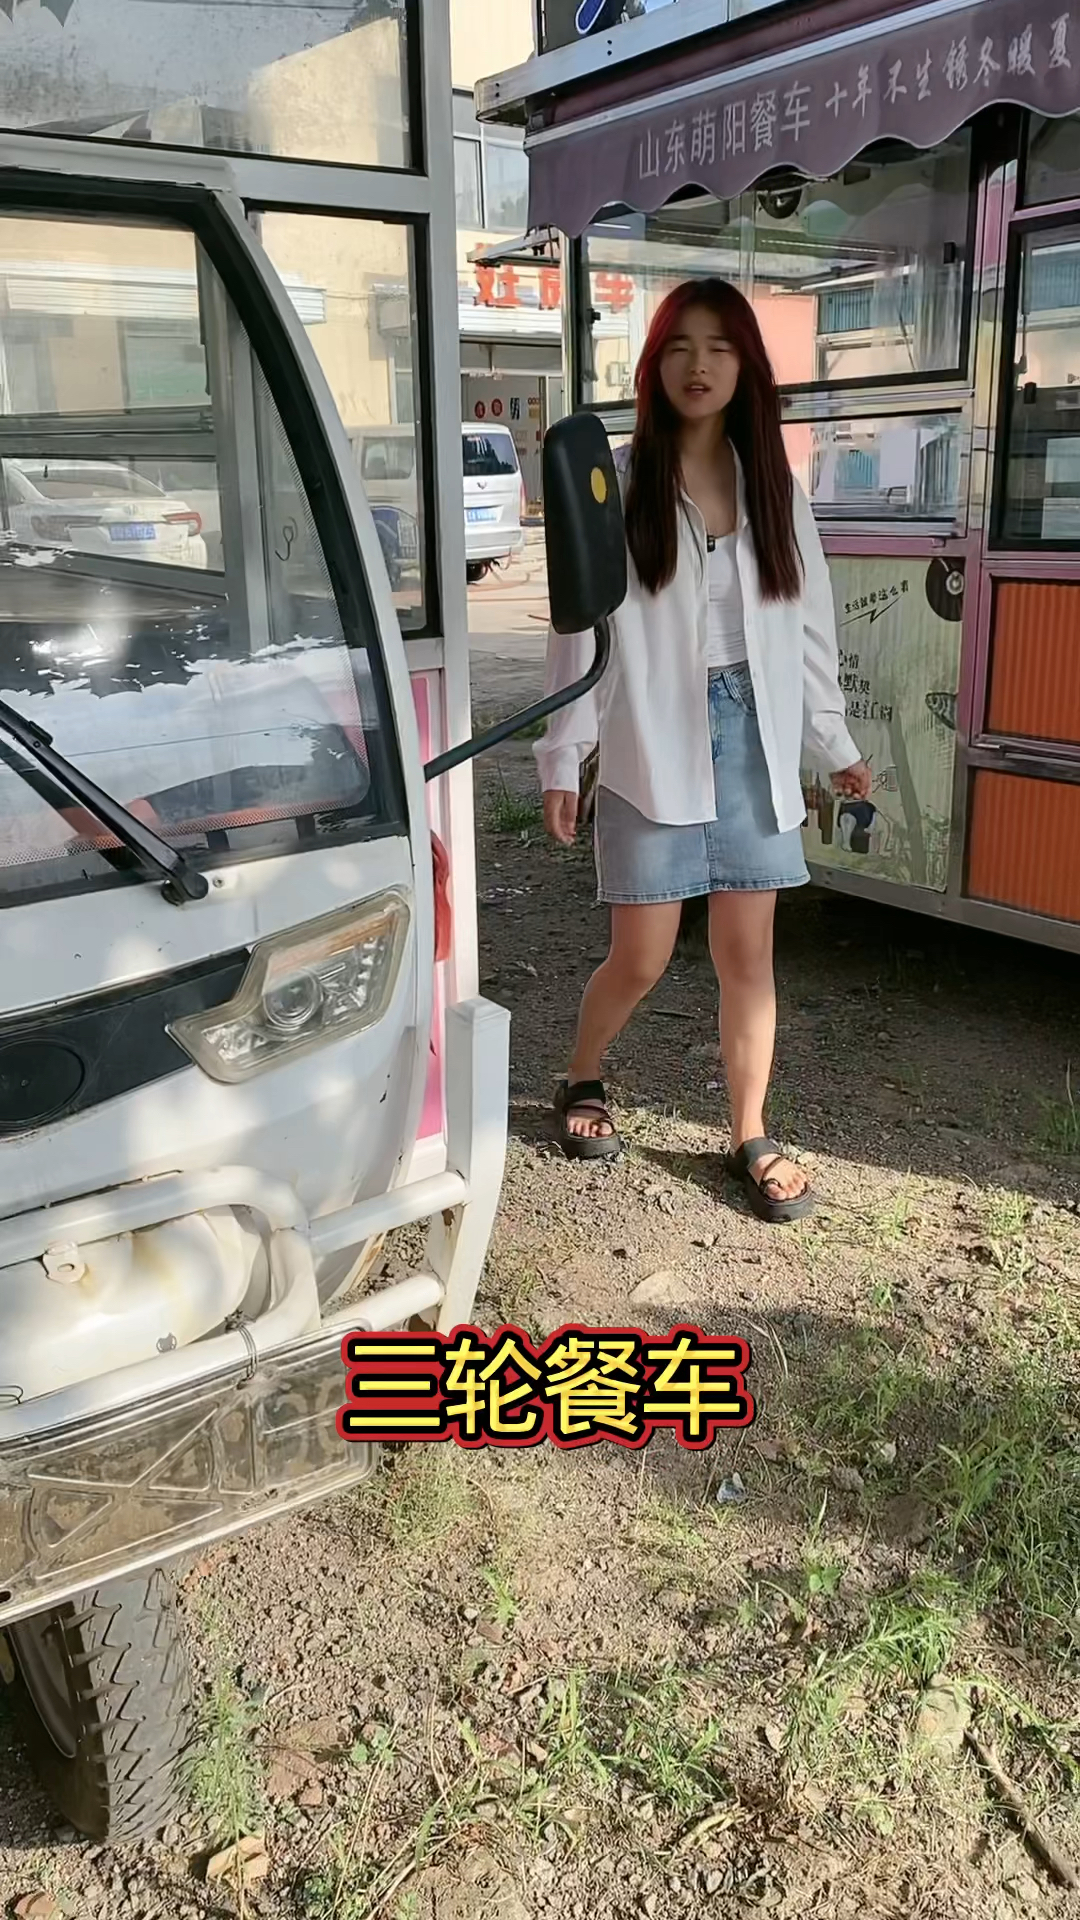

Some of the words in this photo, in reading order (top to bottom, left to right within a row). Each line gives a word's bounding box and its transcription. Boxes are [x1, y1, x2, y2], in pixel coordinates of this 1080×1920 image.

[638, 80, 812, 180] 山东萌阳餐车
[838, 673, 870, 695] 默契
[845, 699, 893, 722] 是江湖
